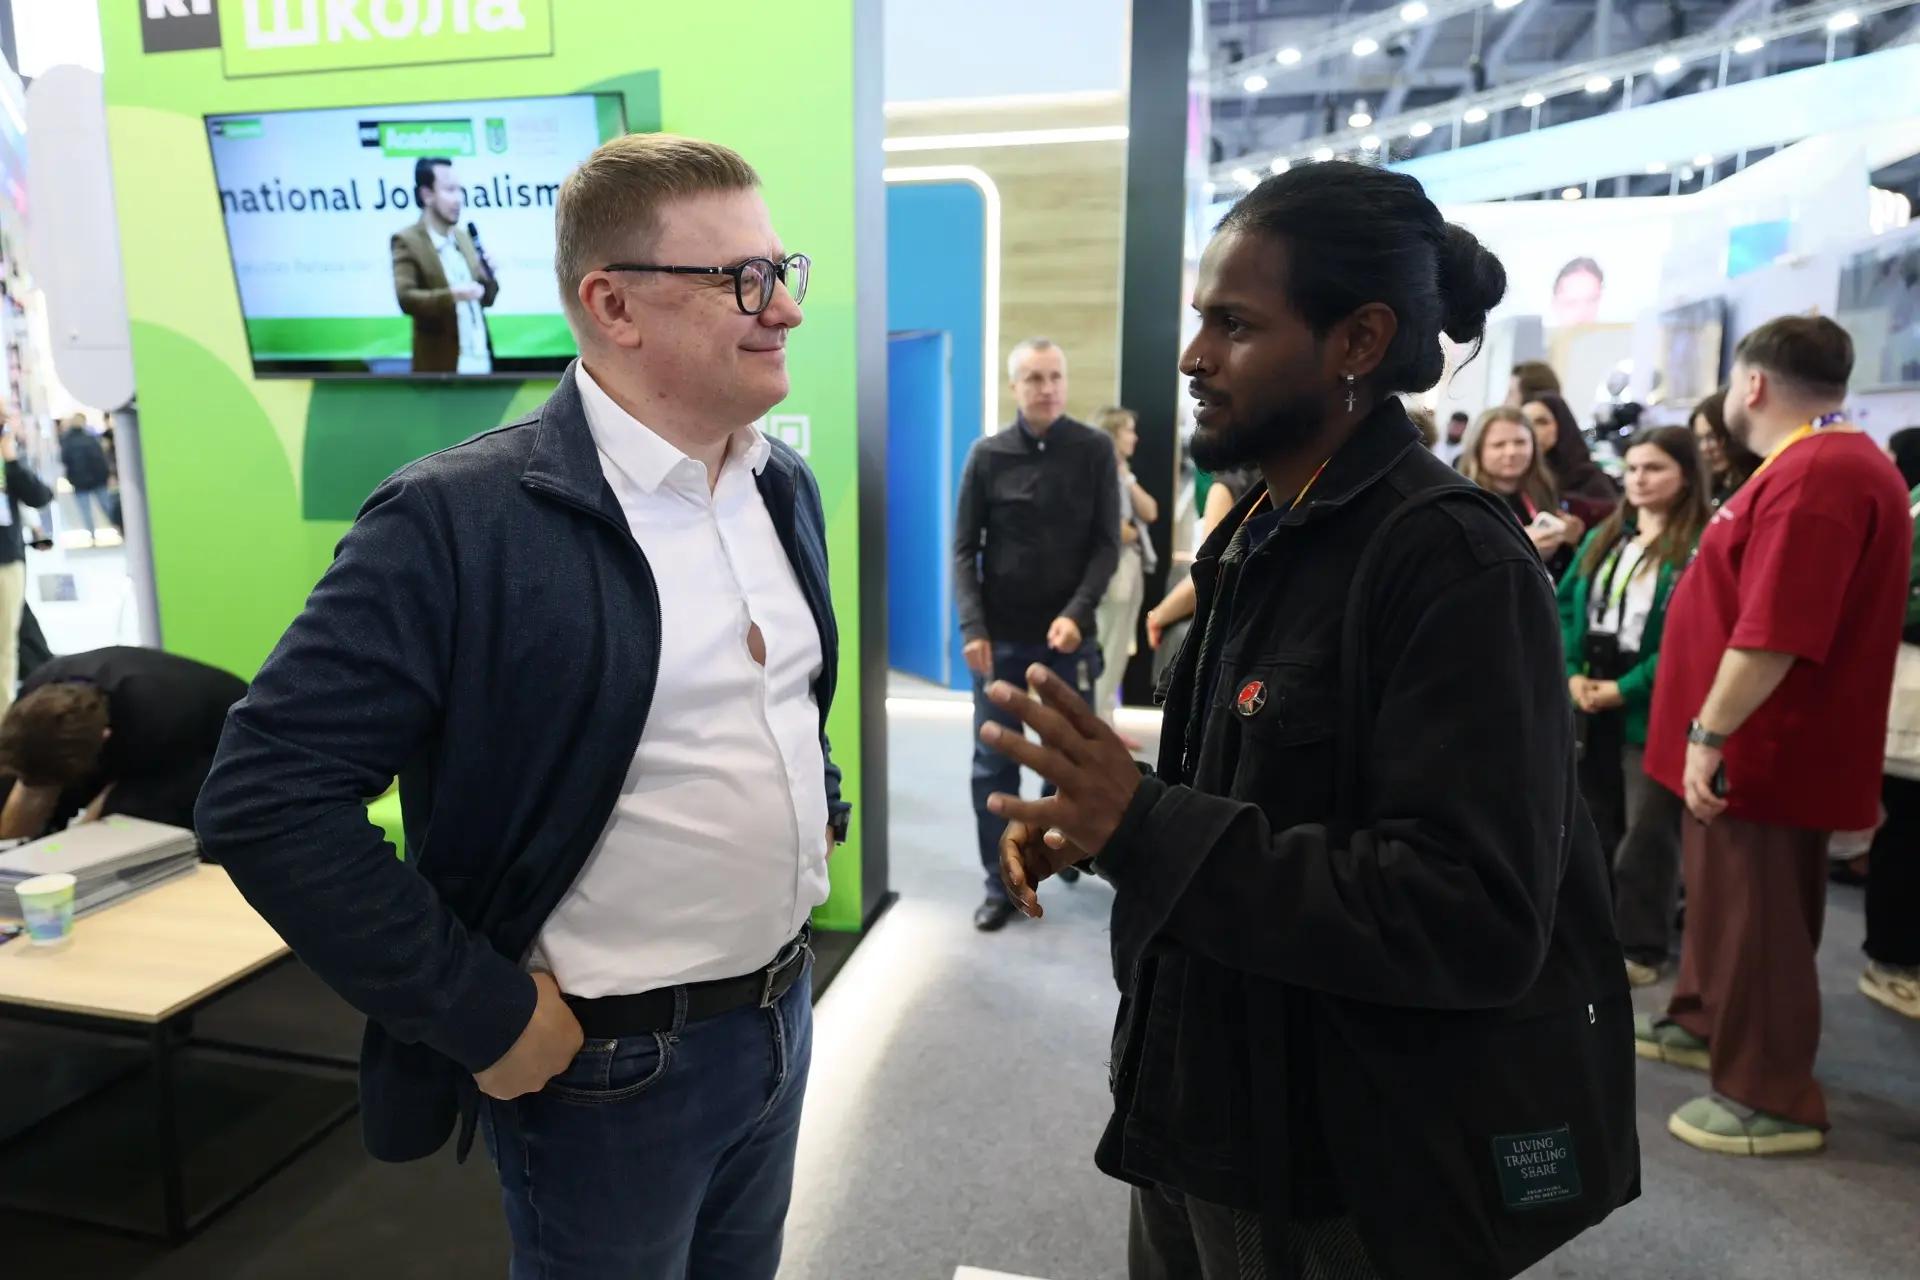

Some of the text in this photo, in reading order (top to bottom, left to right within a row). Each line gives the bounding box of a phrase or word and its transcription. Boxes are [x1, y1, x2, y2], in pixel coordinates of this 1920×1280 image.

[374, 174, 559, 211] Jonalism
[1513, 1137, 1553, 1153] LIVING
[1504, 1148, 1566, 1167] TRAVELING
[1520, 1162, 1558, 1179] SHARE
